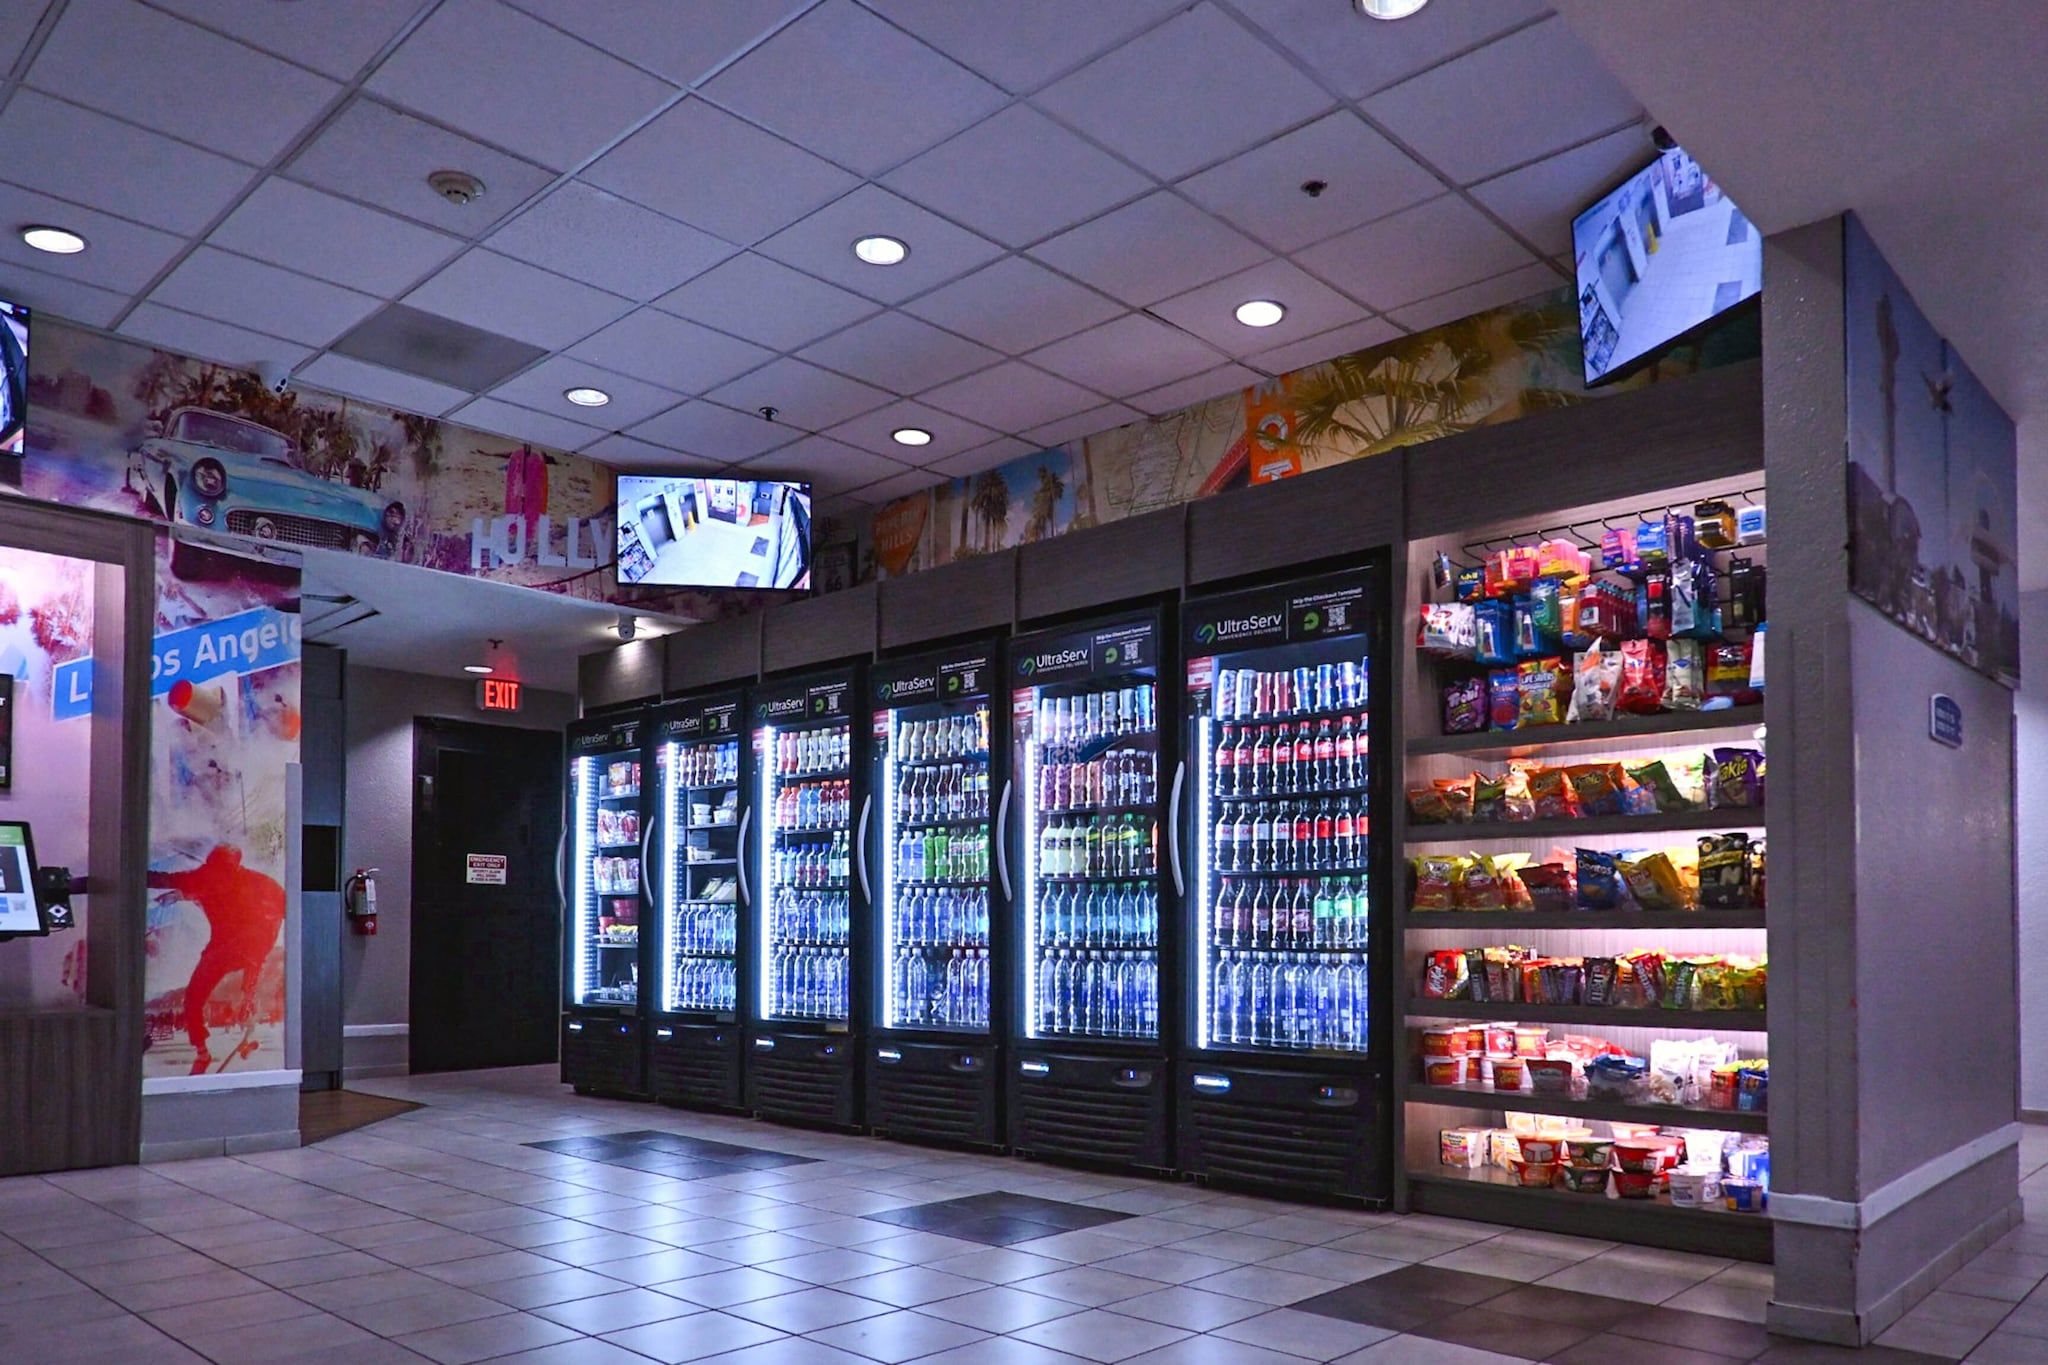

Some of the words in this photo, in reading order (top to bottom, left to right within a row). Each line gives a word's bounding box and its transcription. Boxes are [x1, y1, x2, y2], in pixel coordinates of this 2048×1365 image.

[1216, 613, 1282, 635] UltraServ
[1036, 648, 1089, 668] UltraServ
[892, 677, 935, 693] UltraServ
[485, 680, 518, 709] EXIT
[768, 699, 804, 713] UltraServ
[669, 717, 700, 730] UltraServ
